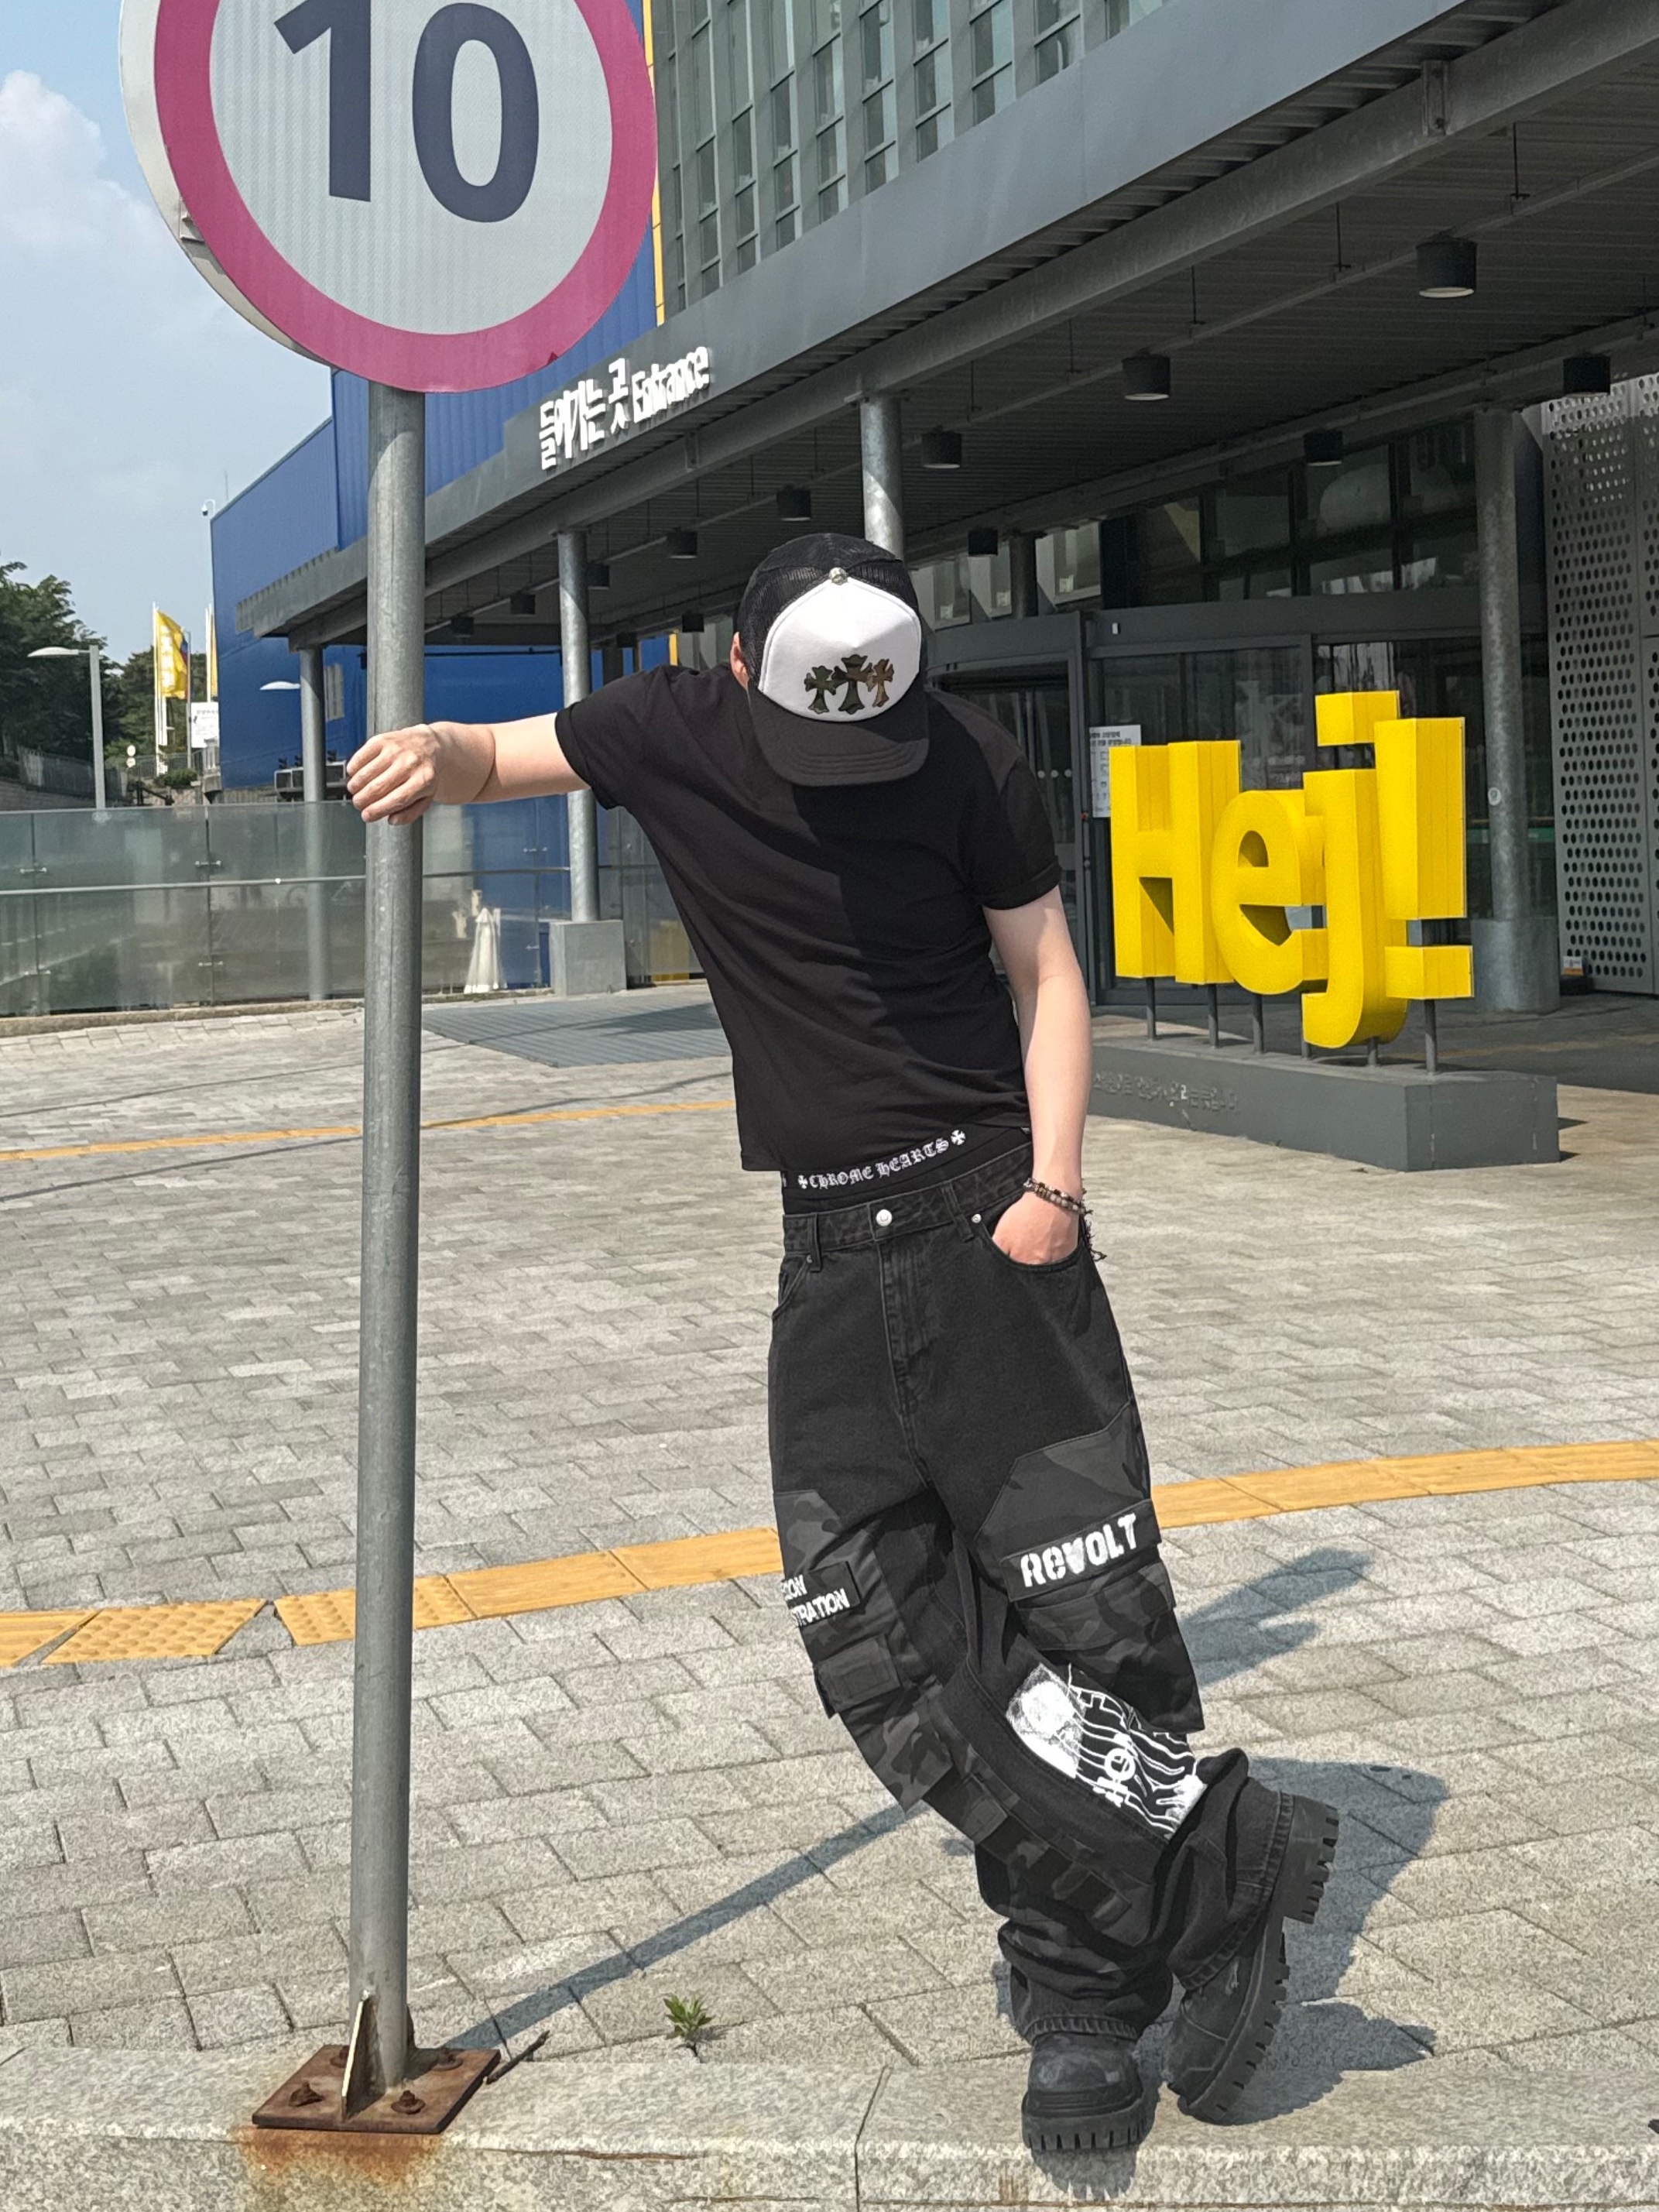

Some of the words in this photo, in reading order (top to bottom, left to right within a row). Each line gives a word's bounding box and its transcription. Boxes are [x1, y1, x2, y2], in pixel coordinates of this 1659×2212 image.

[274, 0, 539, 222] 10
[540, 378, 606, 470] 들어가는
[608, 358, 629, 434] 곳
[632, 346, 709, 424] Entrance
[1109, 691, 1474, 1048] Hej!
[809, 1166, 874, 1189] CHROME
[876, 1137, 949, 1178] HEARTS
